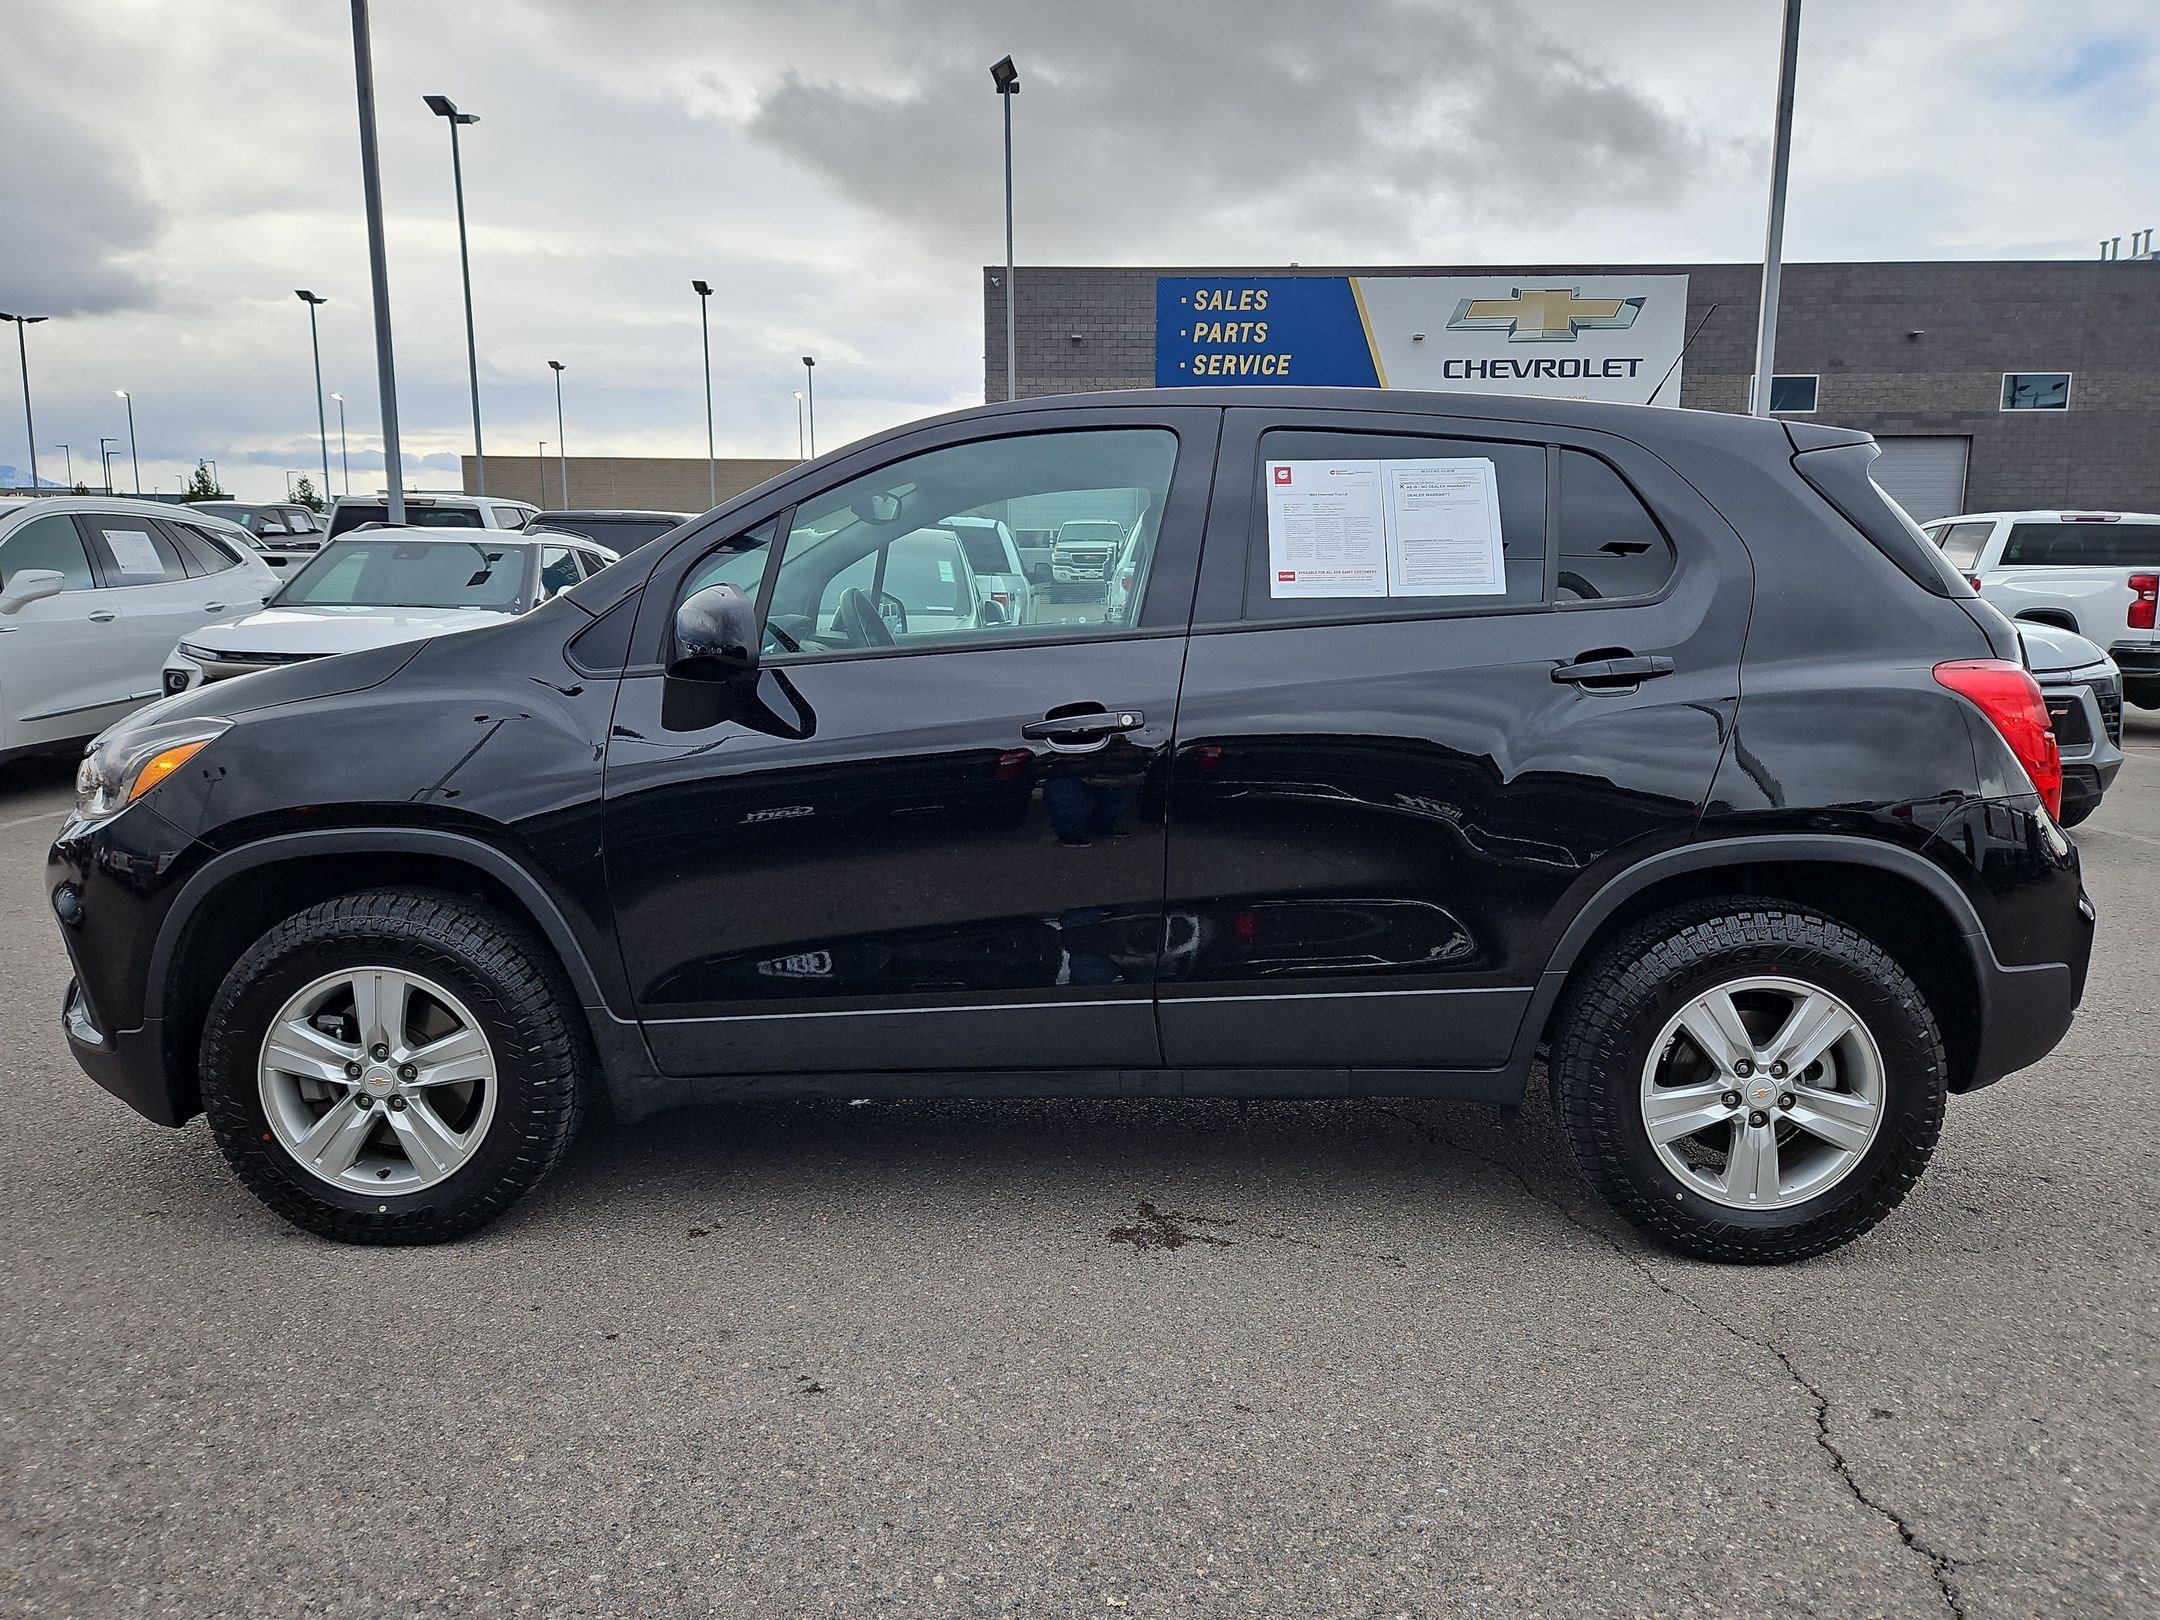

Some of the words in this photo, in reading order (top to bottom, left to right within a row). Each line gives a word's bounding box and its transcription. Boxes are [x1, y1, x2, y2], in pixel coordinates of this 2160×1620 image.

[1194, 289, 1269, 311] SALES
[1193, 322, 1268, 344] PARTS
[1192, 354, 1292, 376] SERVICE
[1443, 357, 1644, 379] CHEVROLET
